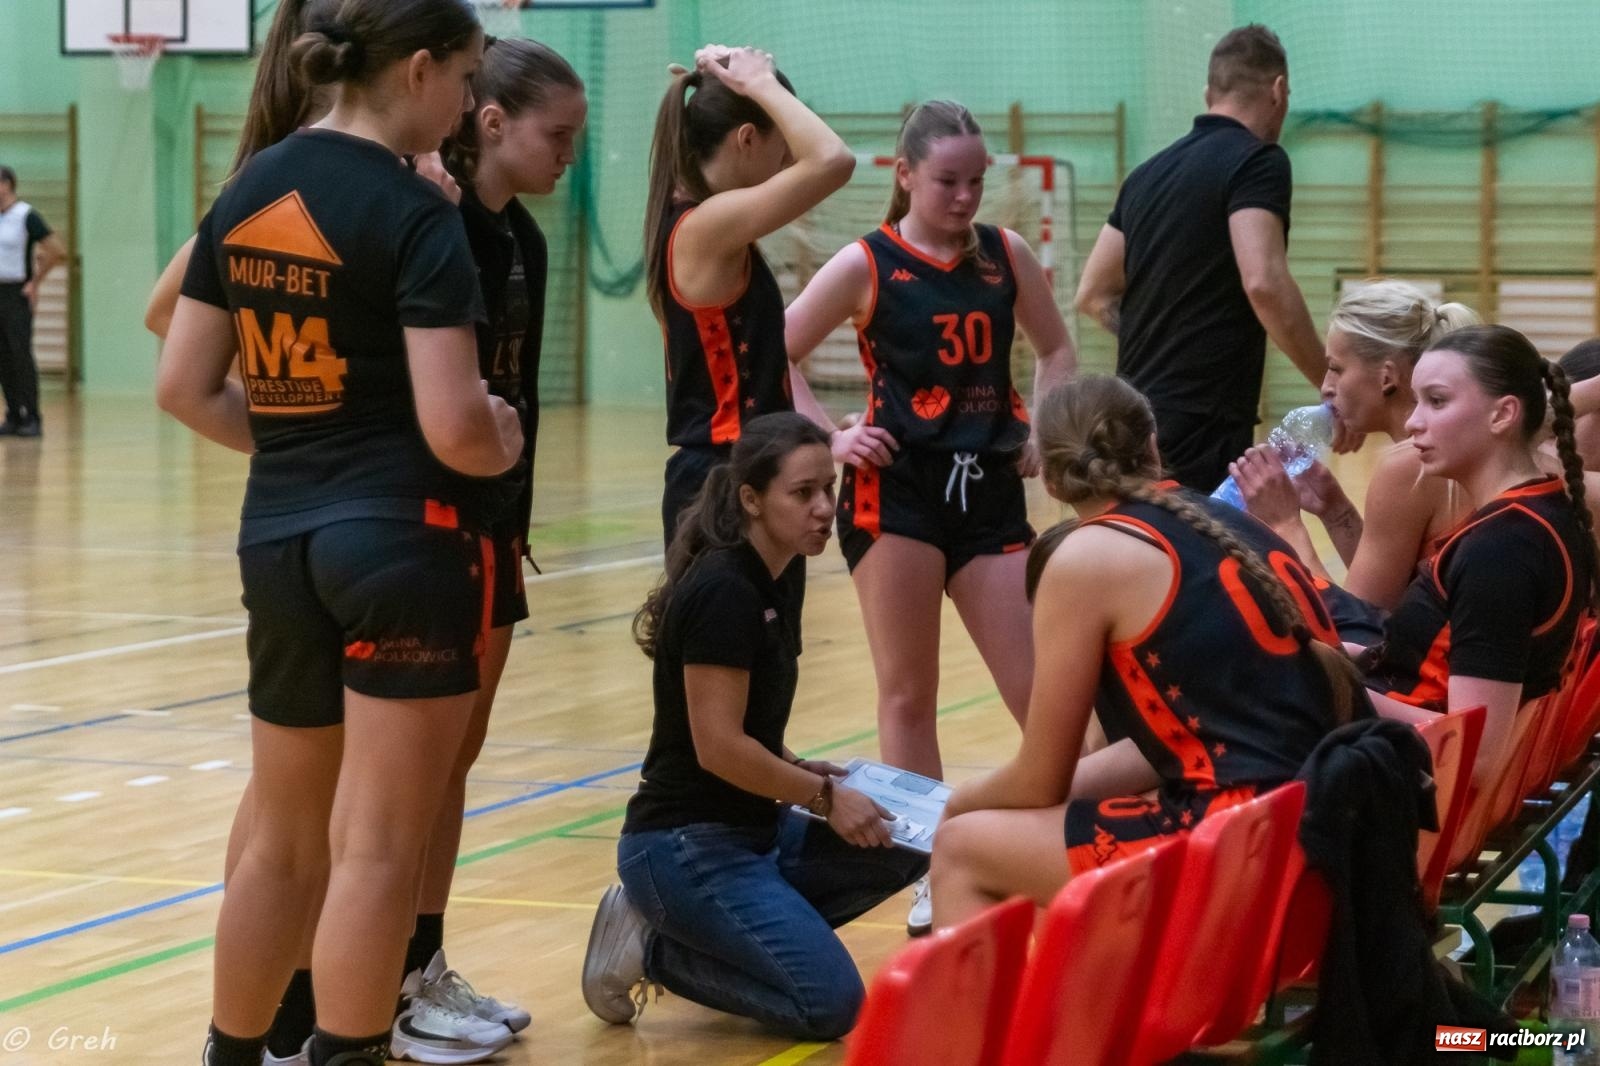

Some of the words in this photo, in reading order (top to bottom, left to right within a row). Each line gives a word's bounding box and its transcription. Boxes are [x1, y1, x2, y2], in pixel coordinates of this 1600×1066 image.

[229, 255, 331, 298] MUR-BET
[239, 307, 347, 392] M4
[932, 311, 992, 365] 30
[250, 378, 323, 394] PRESTIGE
